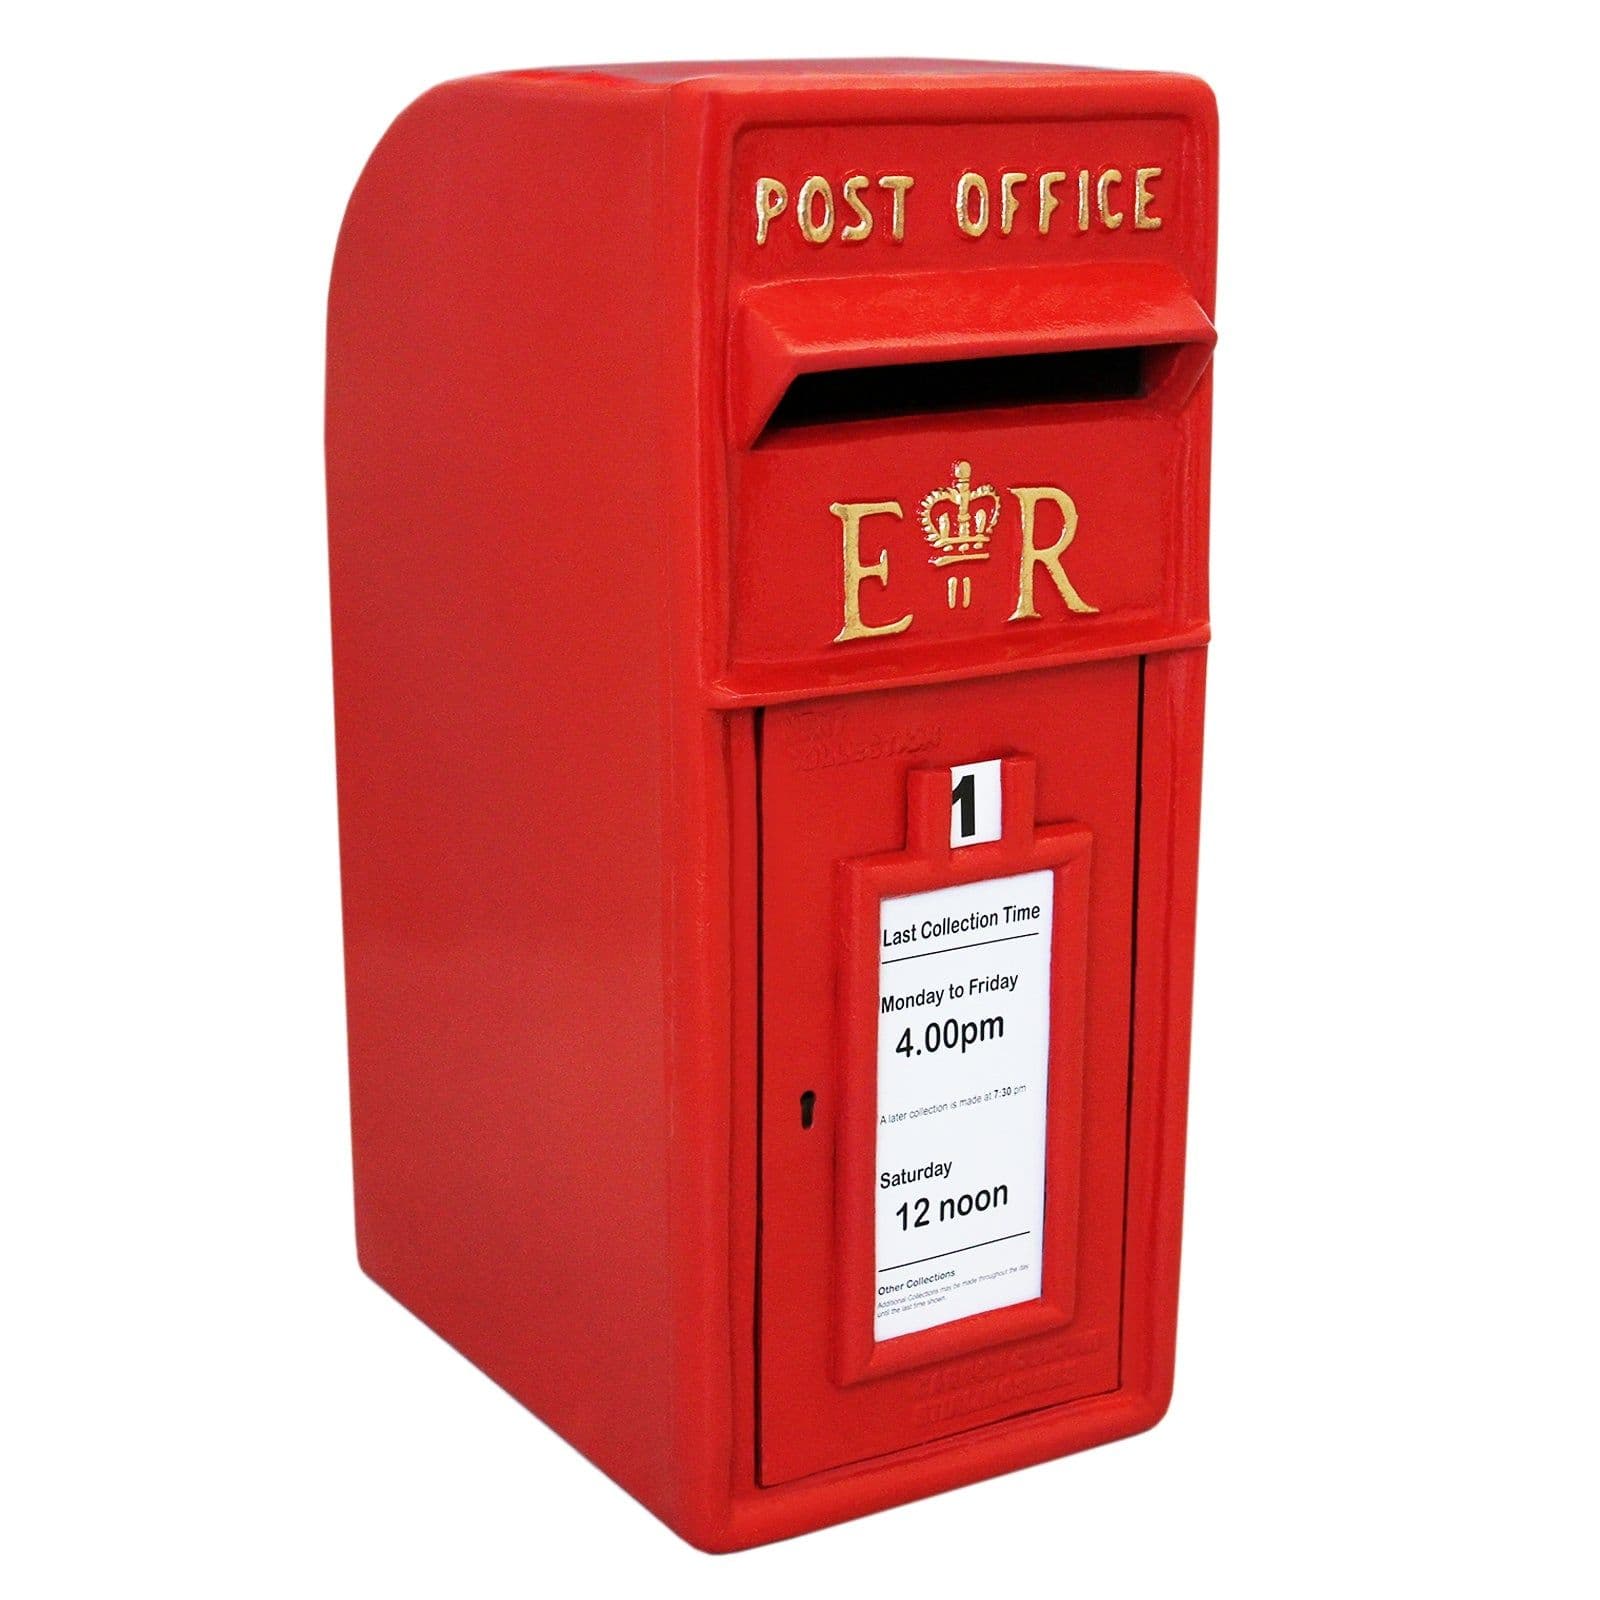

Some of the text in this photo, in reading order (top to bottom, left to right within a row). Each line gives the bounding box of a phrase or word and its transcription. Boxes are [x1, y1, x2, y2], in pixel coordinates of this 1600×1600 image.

[755, 167, 1163, 246] POST OFFICE
[829, 487, 1100, 643] E R
[951, 774, 976, 838] 1
[882, 903, 1042, 948] Last Collection Time
[881, 974, 1020, 1014] Monday to Friday
[895, 1015, 1005, 1058] 4.00pm
[879, 1084, 1028, 1125] A later collection is made at 7:30 pm
[880, 1160, 953, 1190] Saturday
[896, 1184, 1009, 1232] 12 noon
[878, 1270, 956, 1296] Other Collections
